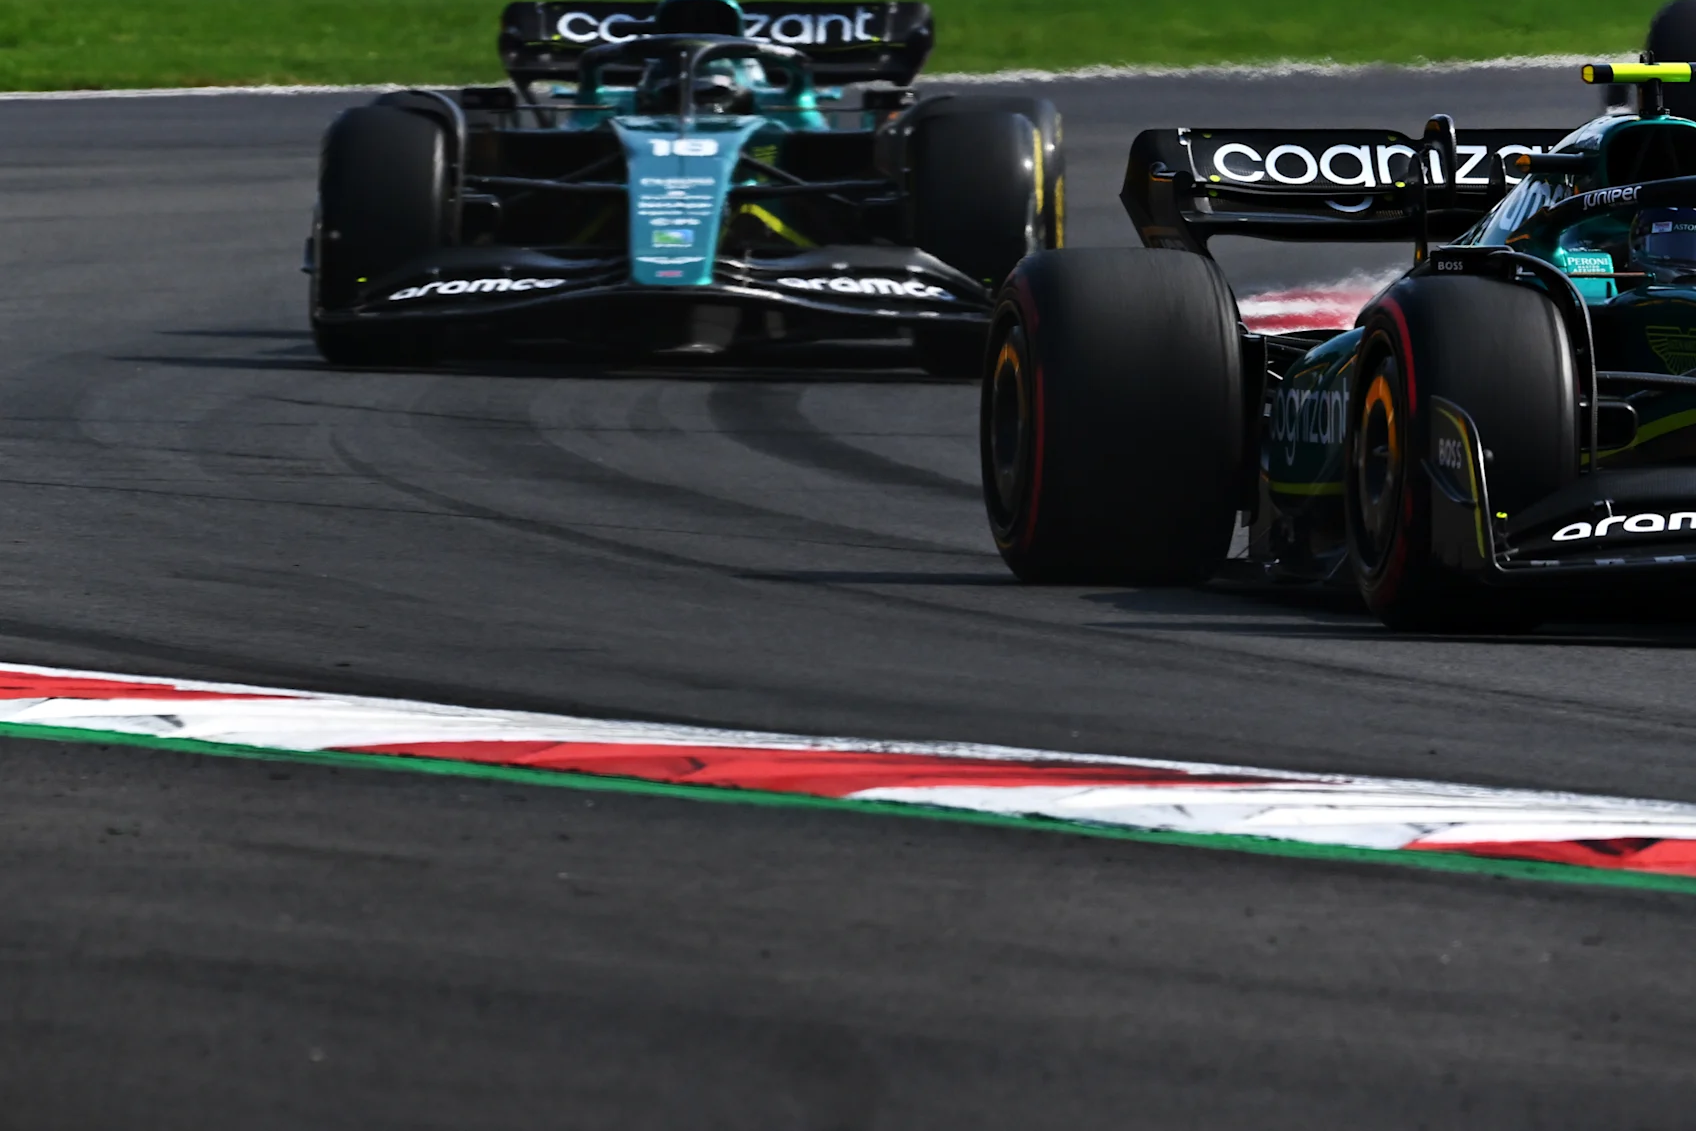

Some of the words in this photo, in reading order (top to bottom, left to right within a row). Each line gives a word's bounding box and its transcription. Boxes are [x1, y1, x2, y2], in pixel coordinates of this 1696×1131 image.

[1437, 261, 1464, 271] BOSS
[1567, 257, 1609, 266] PERONI
[388, 277, 567, 301] aramco
[776, 275, 957, 302] aramco
[1438, 438, 1462, 470] BOSS
